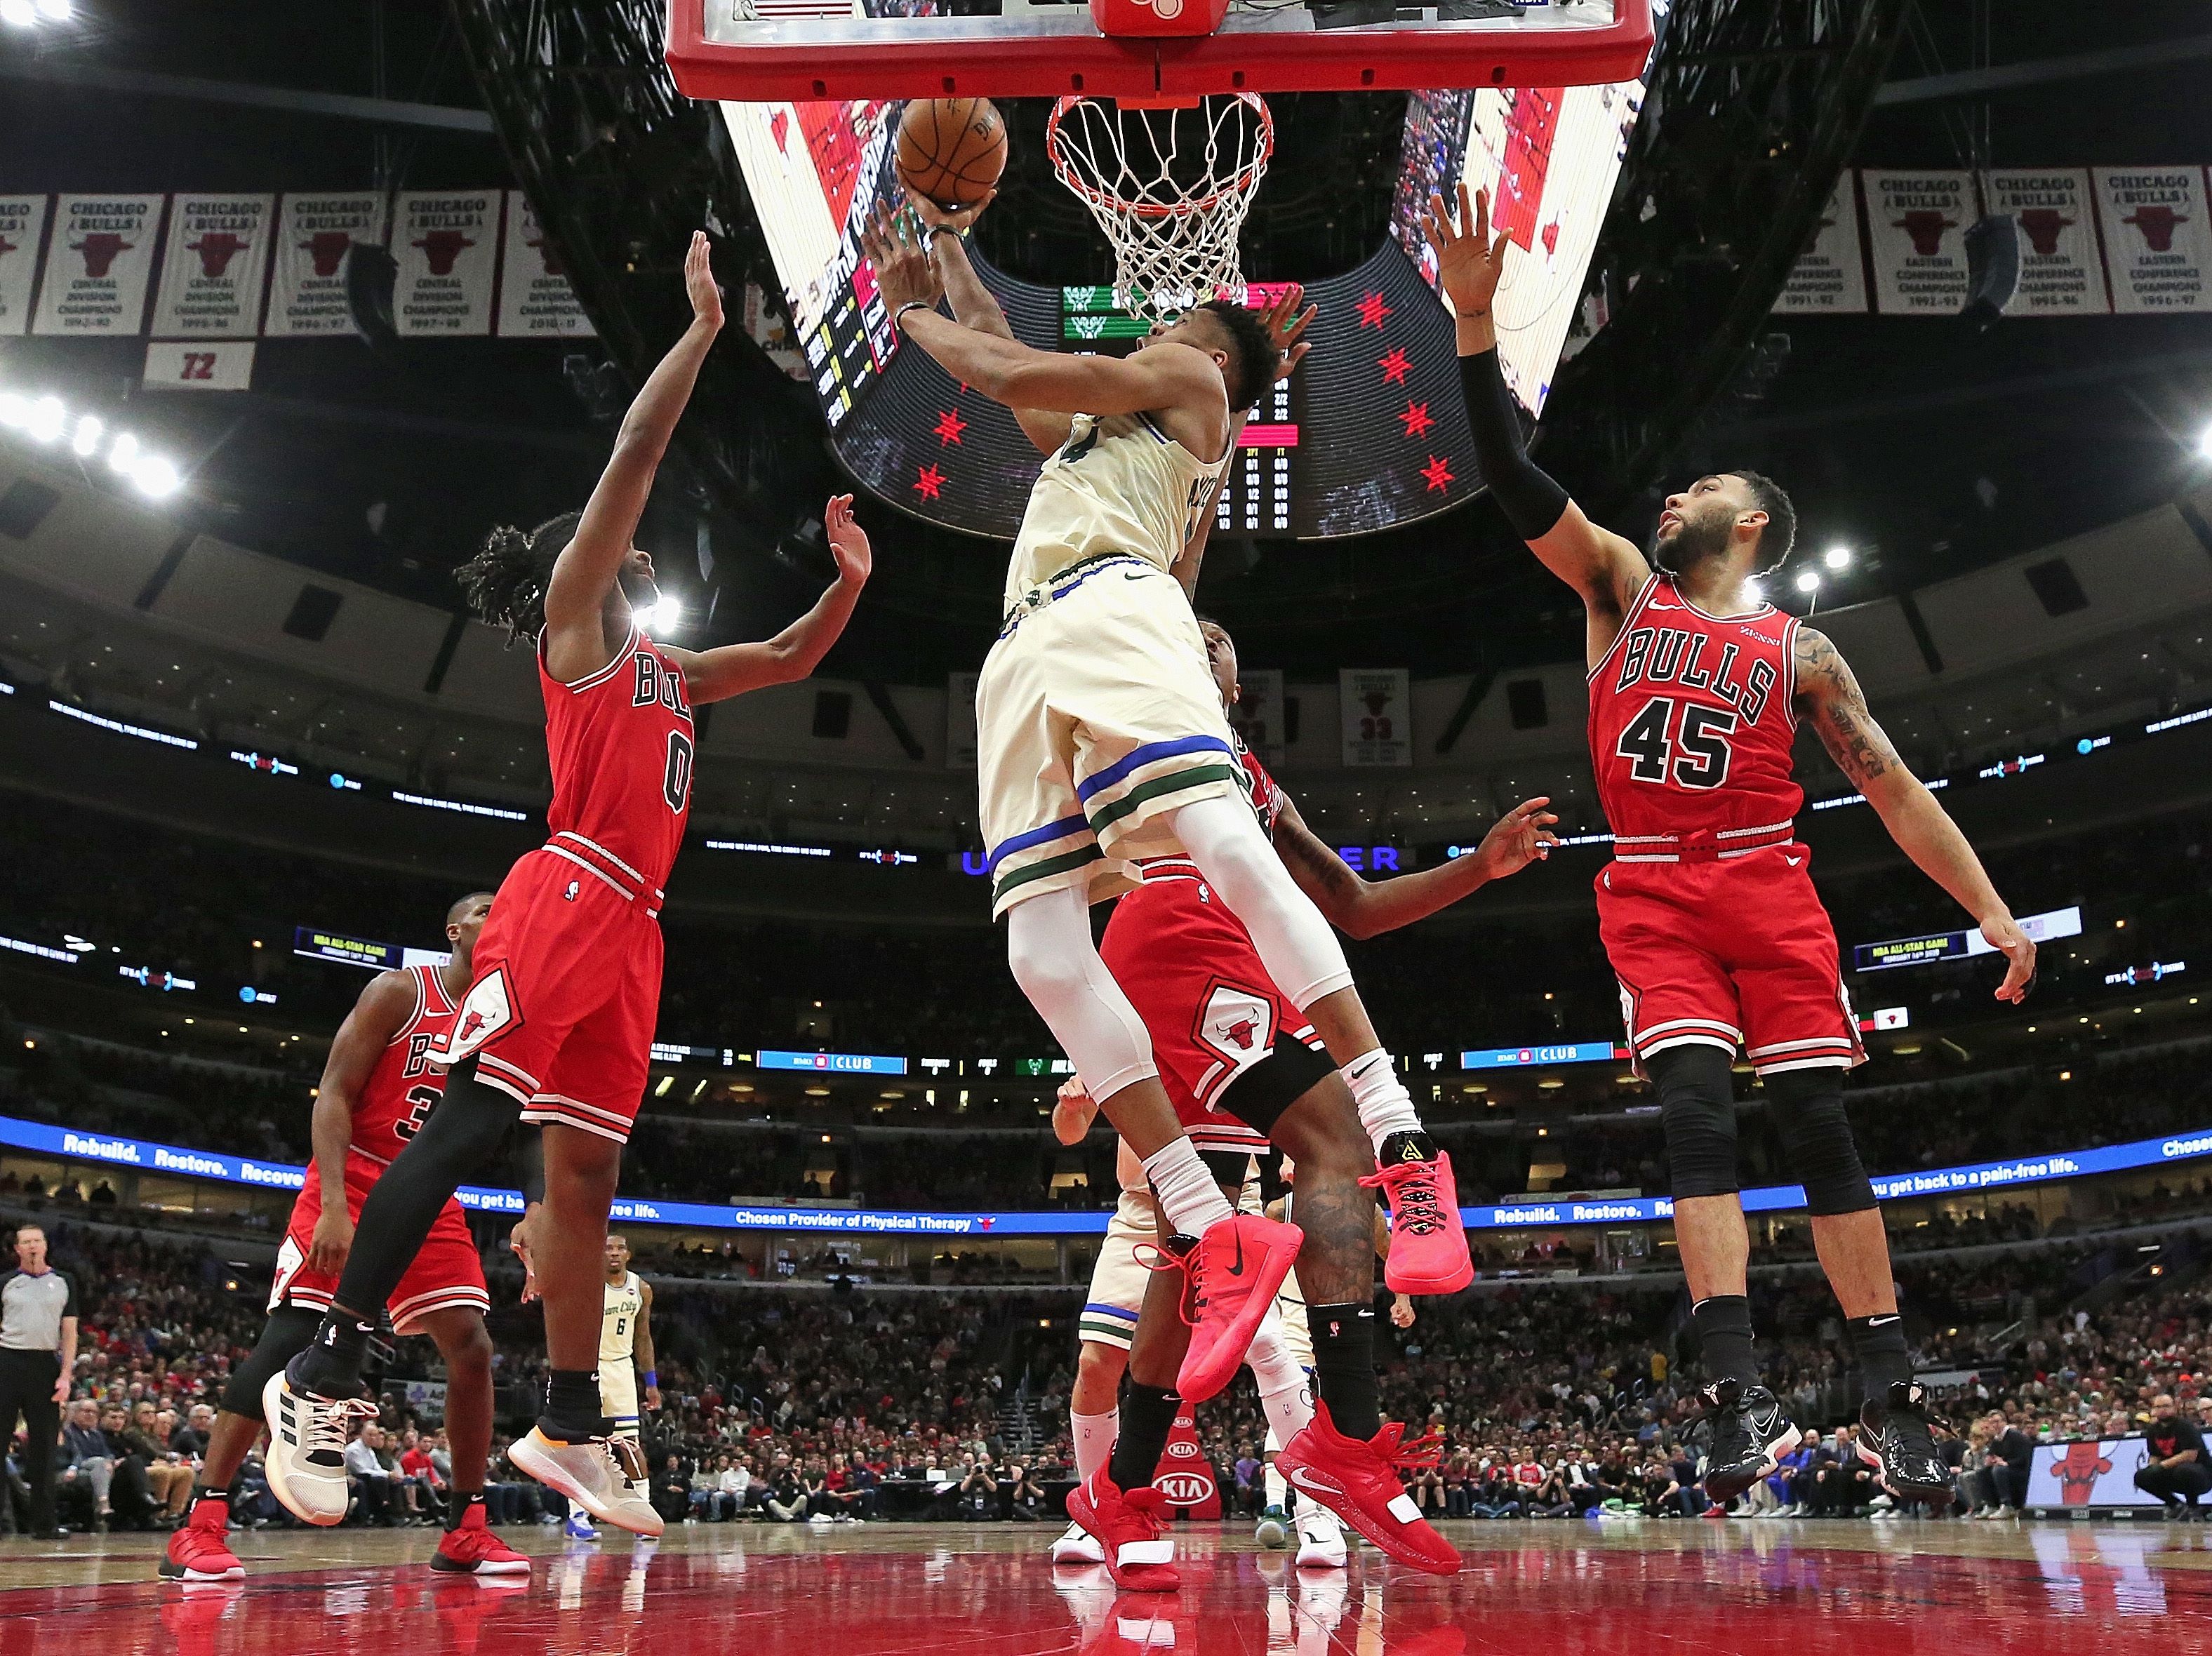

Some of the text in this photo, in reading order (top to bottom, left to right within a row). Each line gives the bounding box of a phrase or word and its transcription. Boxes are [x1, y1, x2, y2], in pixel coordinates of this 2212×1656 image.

[1879, 180, 1959, 192] CHICAGO
[1995, 178, 2074, 190] CHICAGO
[2109, 175, 2189, 188] CHICAGO
[1895, 196, 1951, 207] BULLS
[2012, 194, 2067, 206] BULLS
[2125, 191, 2180, 203] BULLS
[70, 203, 147, 215] CHICAGO
[185, 202, 262, 215] CHICAGO
[295, 201, 372, 213] CHICAGO
[408, 199, 486, 212] CHICAGO
[79, 218, 134, 229] BULLS
[420, 215, 474, 227] BULLS
[181, 352, 216, 379] 72
[1615, 627, 1777, 726] BULLS
[632, 651, 691, 721] BUL
[1616, 696, 1739, 790] 45
[663, 728, 693, 815] 0
[1540, 1047, 1578, 1061] CLUB
[836, 1055, 872, 1070] CLUB
[63, 1133, 305, 1187] Rebuild. Restore. Recove
[1871, 1157, 2079, 1197] ou get back to a pain-free life.
[481, 1195, 503, 1209] get
[506, 1194, 524, 1208] ba
[634, 1204, 660, 1218] life.
[1494, 1207, 1560, 1224] Rebuild.
[1573, 1204, 1641, 1221] Restore.
[735, 1210, 971, 1233] Chosen Provider of Physical Therapy
[620, 1300, 637, 1316] City
[616, 1318, 626, 1335] 6
[1175, 1417, 1190, 1426] KIA
[1173, 1445, 1193, 1455] KIA
[1162, 1479, 1203, 1497] KIA
